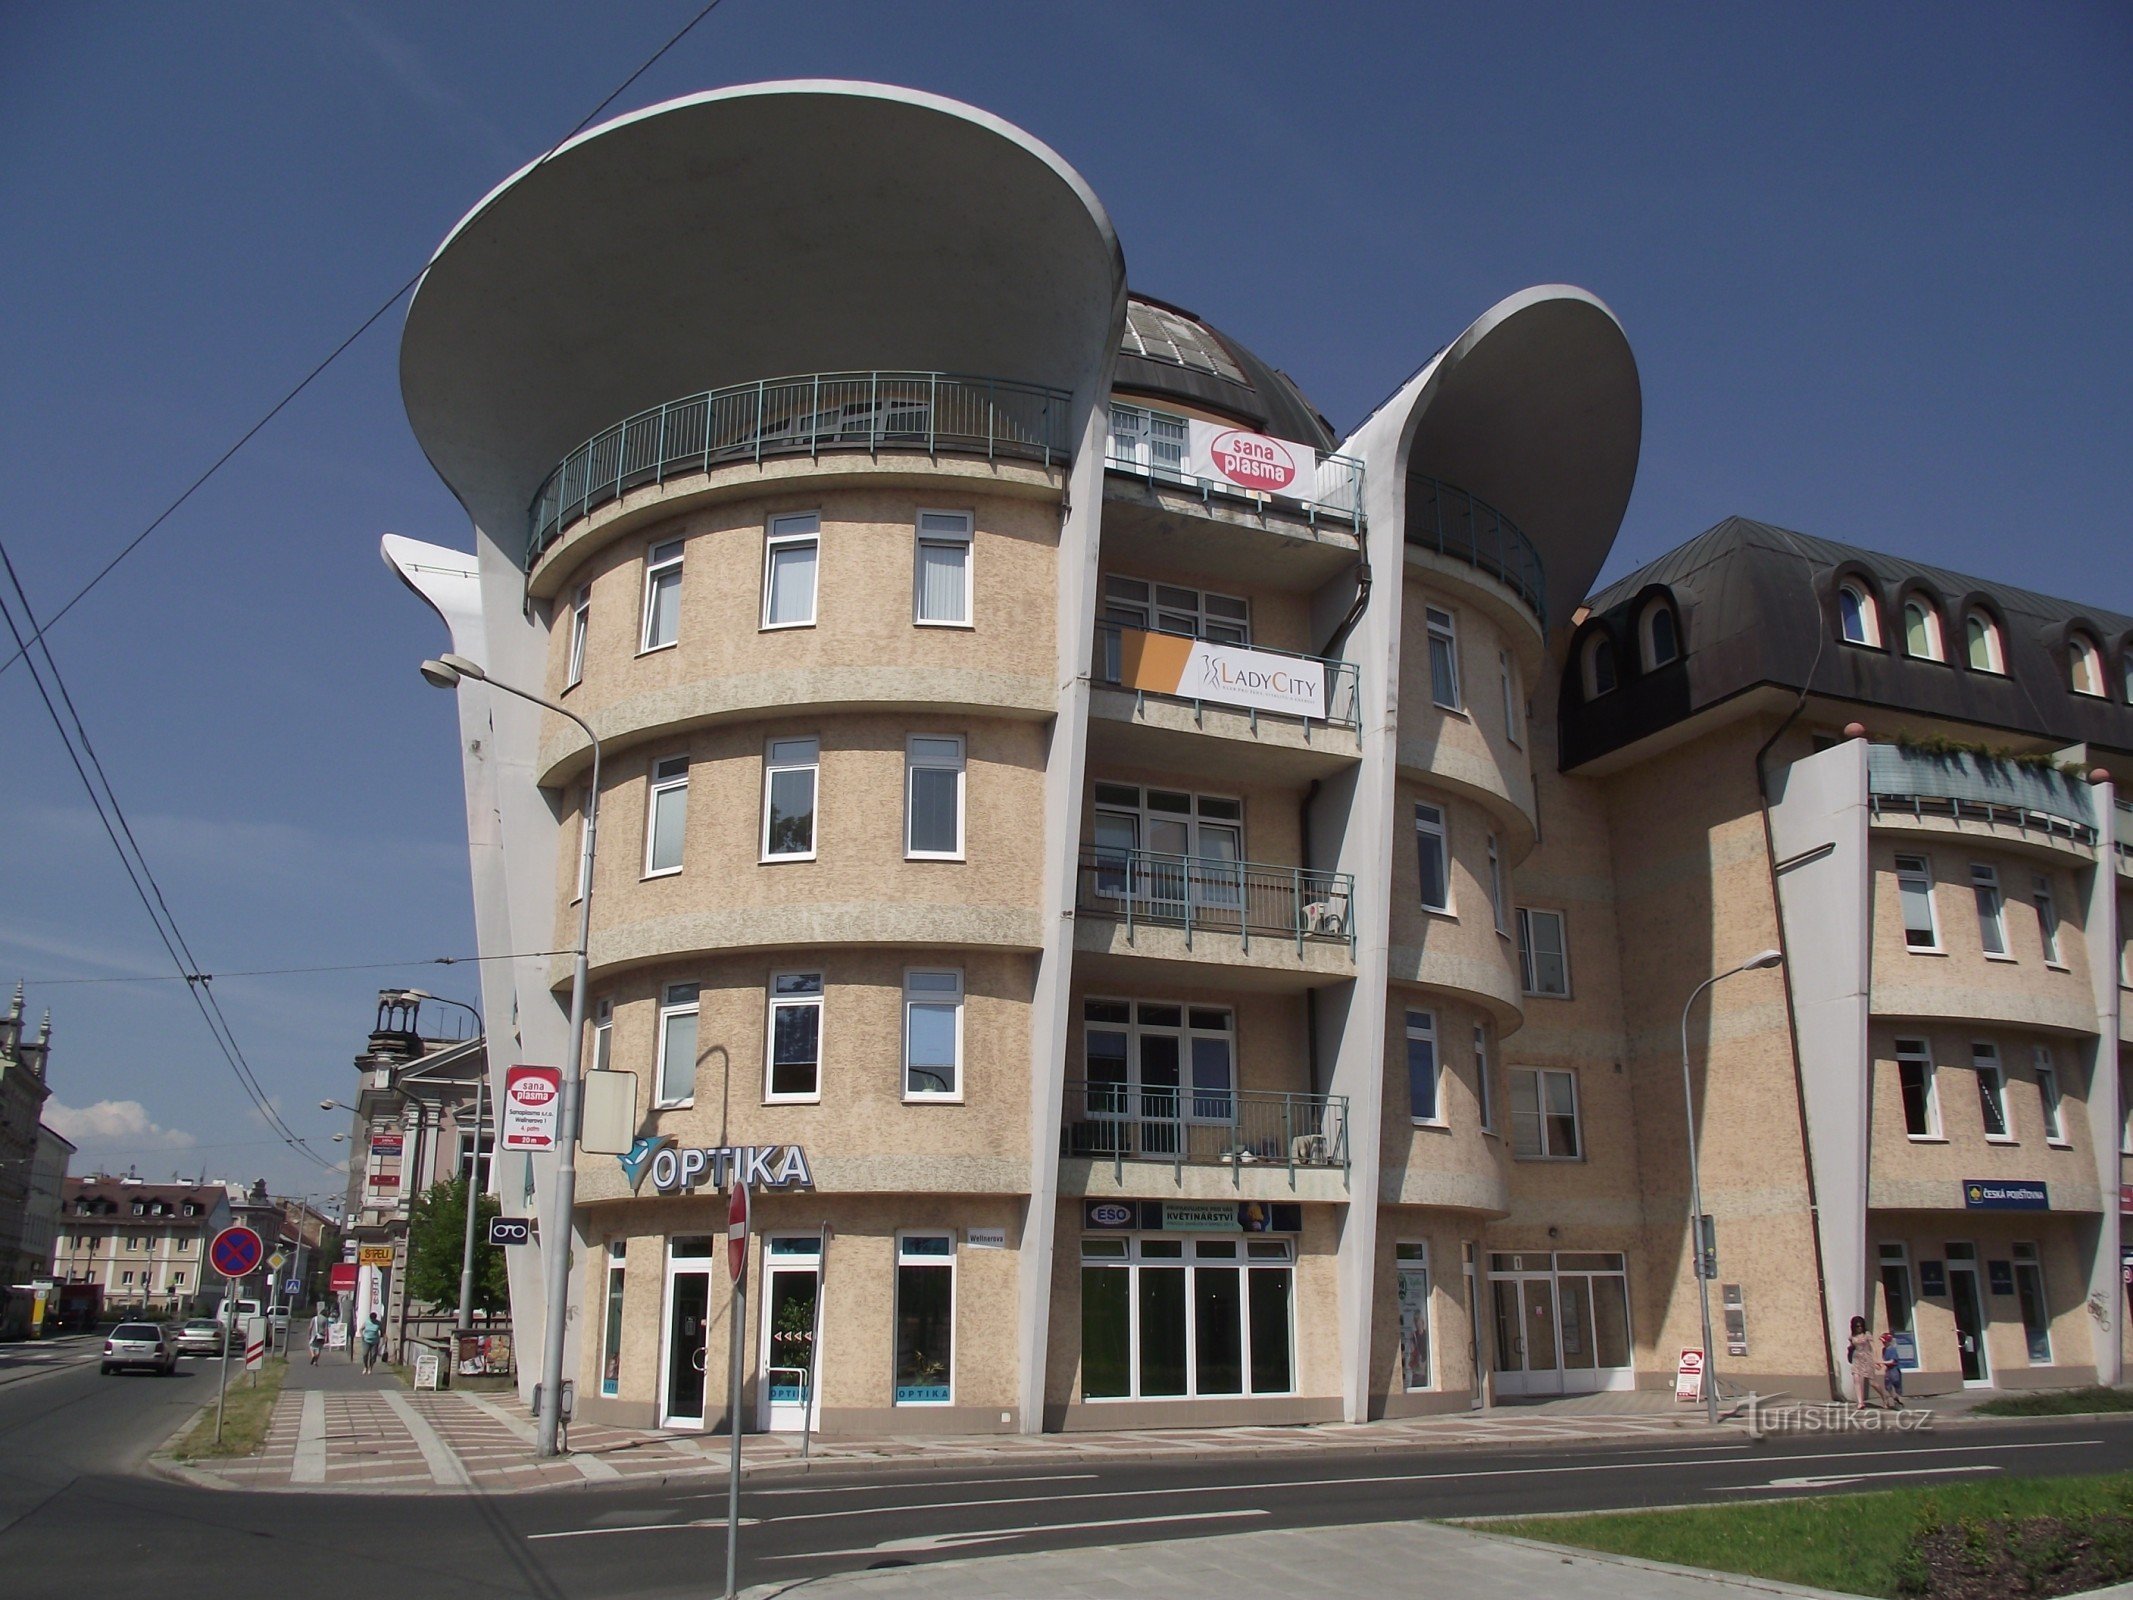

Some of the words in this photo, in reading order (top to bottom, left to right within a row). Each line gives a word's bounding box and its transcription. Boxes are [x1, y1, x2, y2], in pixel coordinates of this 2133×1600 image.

[1233, 439, 1274, 461] sana
[1224, 455, 1285, 483] plasma
[517, 1091, 548, 1101] plasma
[652, 1145, 813, 1190] OPTIKA
[1983, 1188, 2006, 1198] ČESKÁ
[1097, 1209, 1127, 1220] ESO
[1167, 1211, 1233, 1221] KVĚTINÁŘSTVÍ
[898, 1390, 949, 1398] OPTIKA
